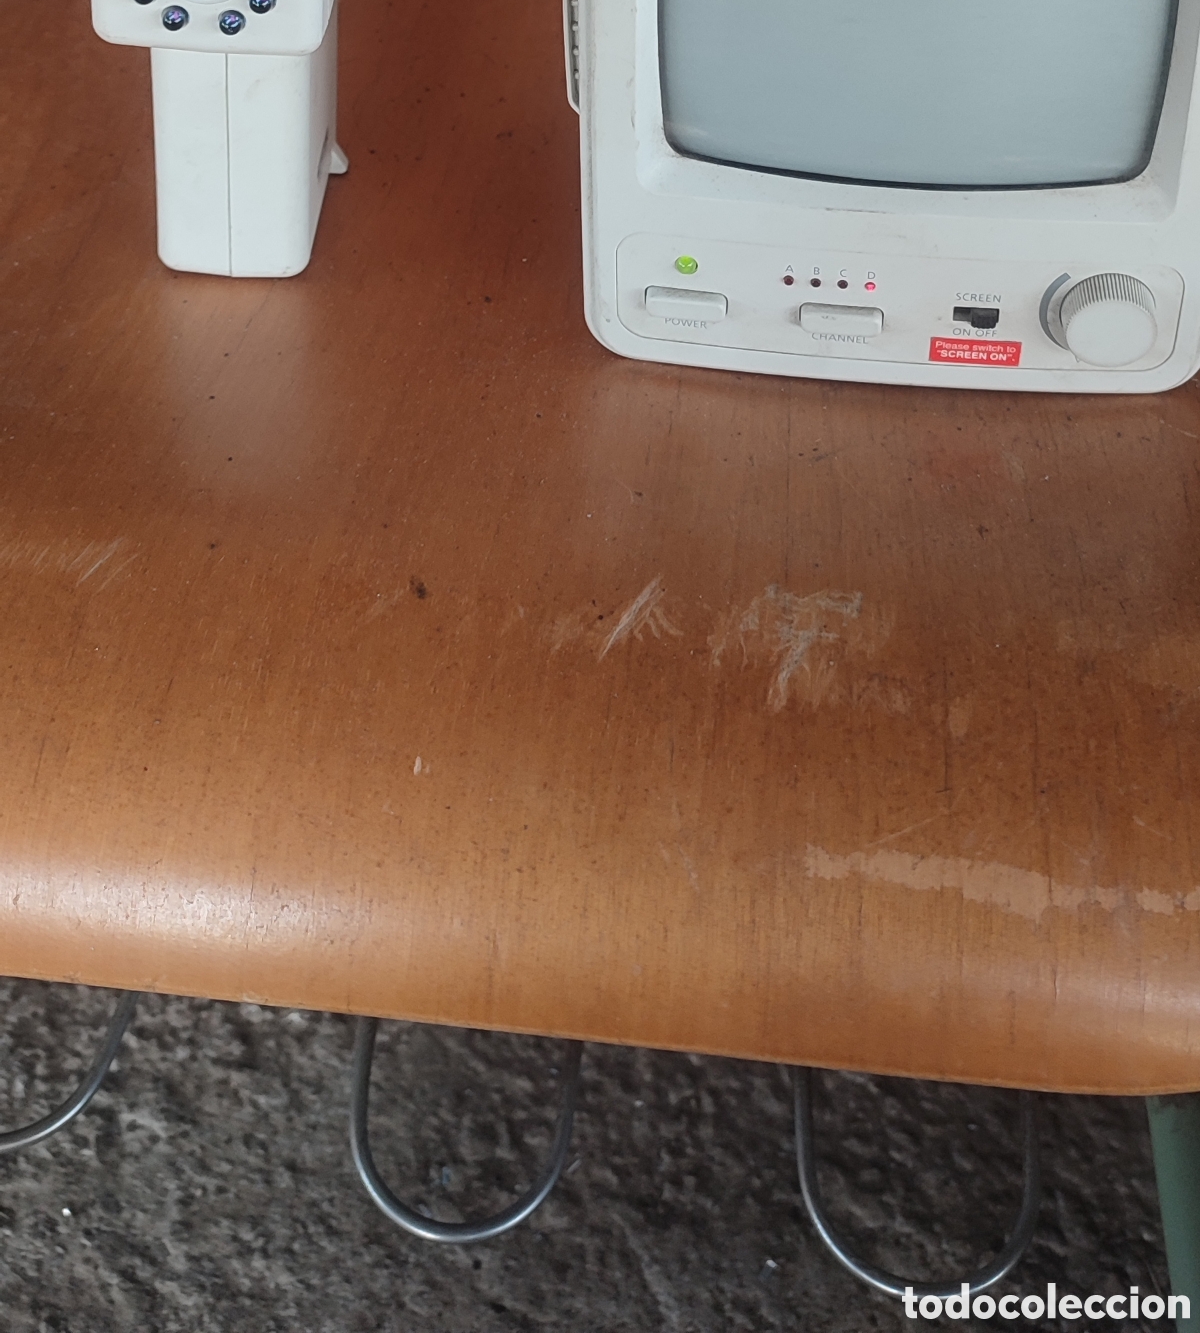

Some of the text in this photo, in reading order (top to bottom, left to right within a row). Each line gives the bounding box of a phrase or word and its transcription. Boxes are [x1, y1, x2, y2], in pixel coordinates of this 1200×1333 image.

[785, 264, 876, 279] A B C D
[955, 292, 1002, 303] SCREEN
[664, 317, 708, 329] POWER
[811, 332, 869, 344] CHANNEL
[952, 327, 997, 337] ON OFF
[935, 340, 1017, 353] Please switch to
